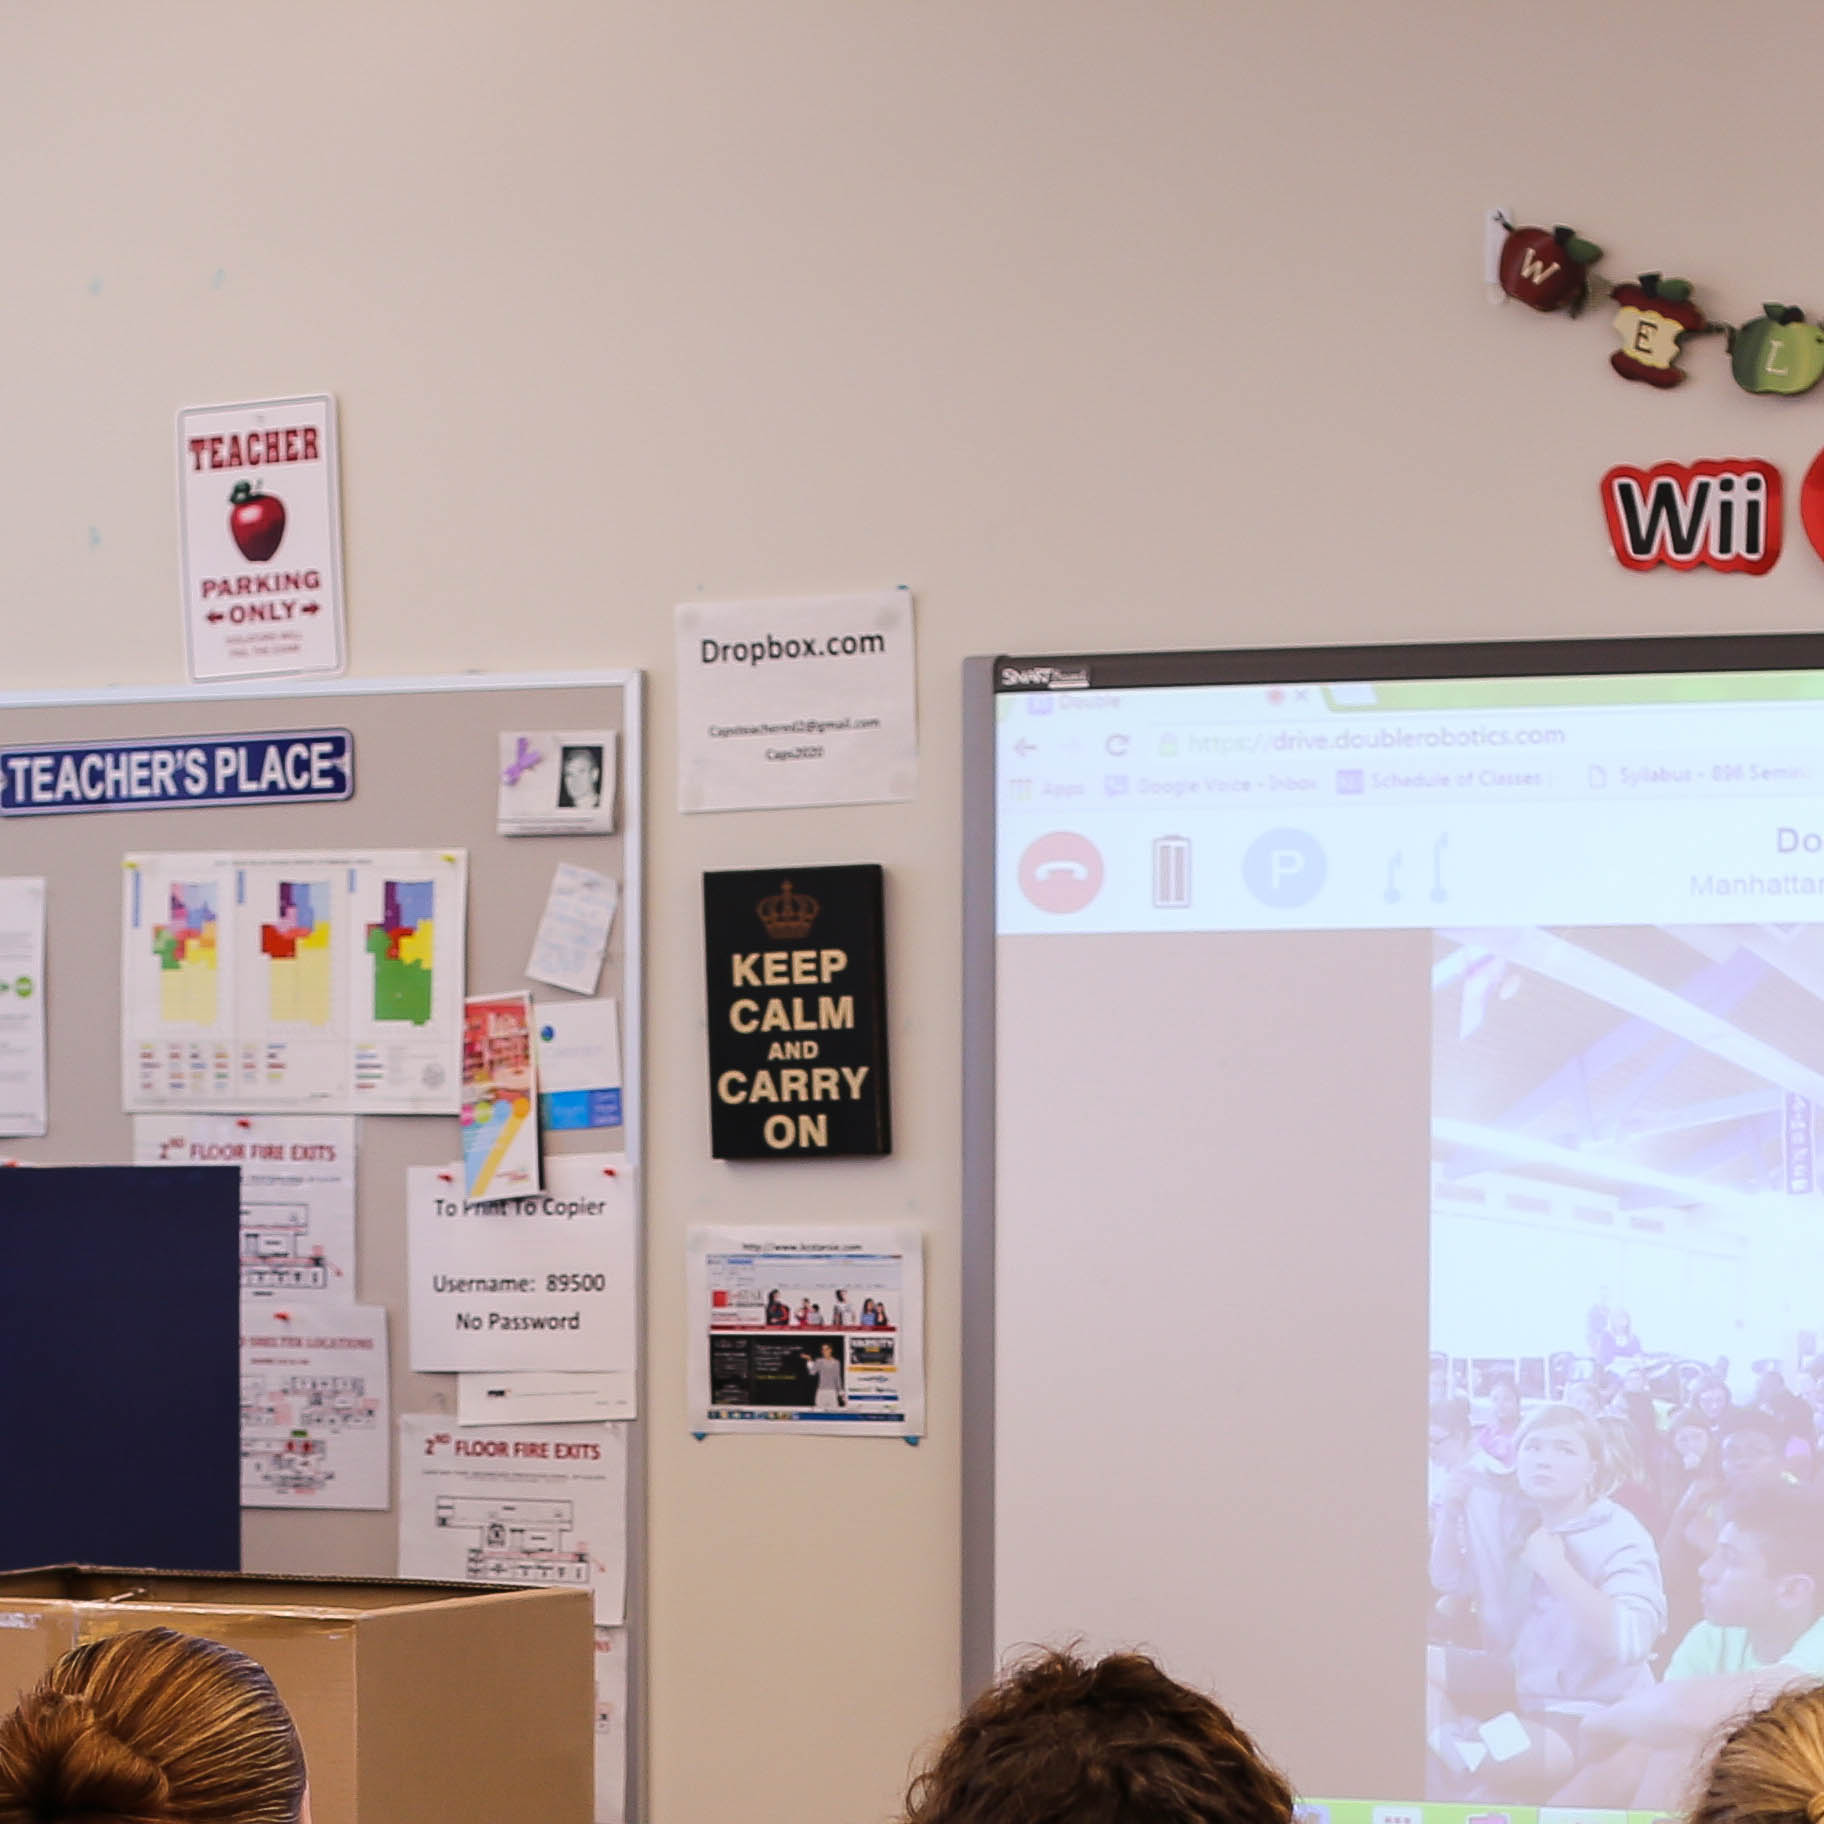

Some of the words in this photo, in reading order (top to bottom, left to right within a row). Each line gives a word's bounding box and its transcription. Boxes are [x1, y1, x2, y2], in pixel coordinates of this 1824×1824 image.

[189, 427, 318, 471] TEACHER
[1616, 476, 1764, 557] Wii
[203, 571, 320, 598] PARKING
[230, 601, 296, 624] ONLY
[701, 633, 886, 666] Dropbox.com
[8, 749, 208, 803] TEACHER'S
[215, 742, 334, 793] PLACE
[731, 949, 848, 986] KEEP
[729, 996, 854, 1034] CALM
[767, 1040, 820, 1061] AND
[717, 1067, 870, 1104] CARRY
[763, 1115, 828, 1149] ON
[190, 1144, 246, 1161] FLOOR
[250, 1144, 286, 1161] FIRE
[290, 1144, 336, 1162] EXITS
[435, 1199, 457, 1216] To
[543, 1197, 606, 1219] Copier
[433, 1274, 535, 1294] Username:
[546, 1274, 606, 1293] 89500
[456, 1312, 483, 1331] No
[489, 1311, 581, 1331] Password
[455, 1441, 510, 1459] FLOOR
[513, 1441, 550, 1460] FIRE
[554, 1442, 601, 1461] EXITS
